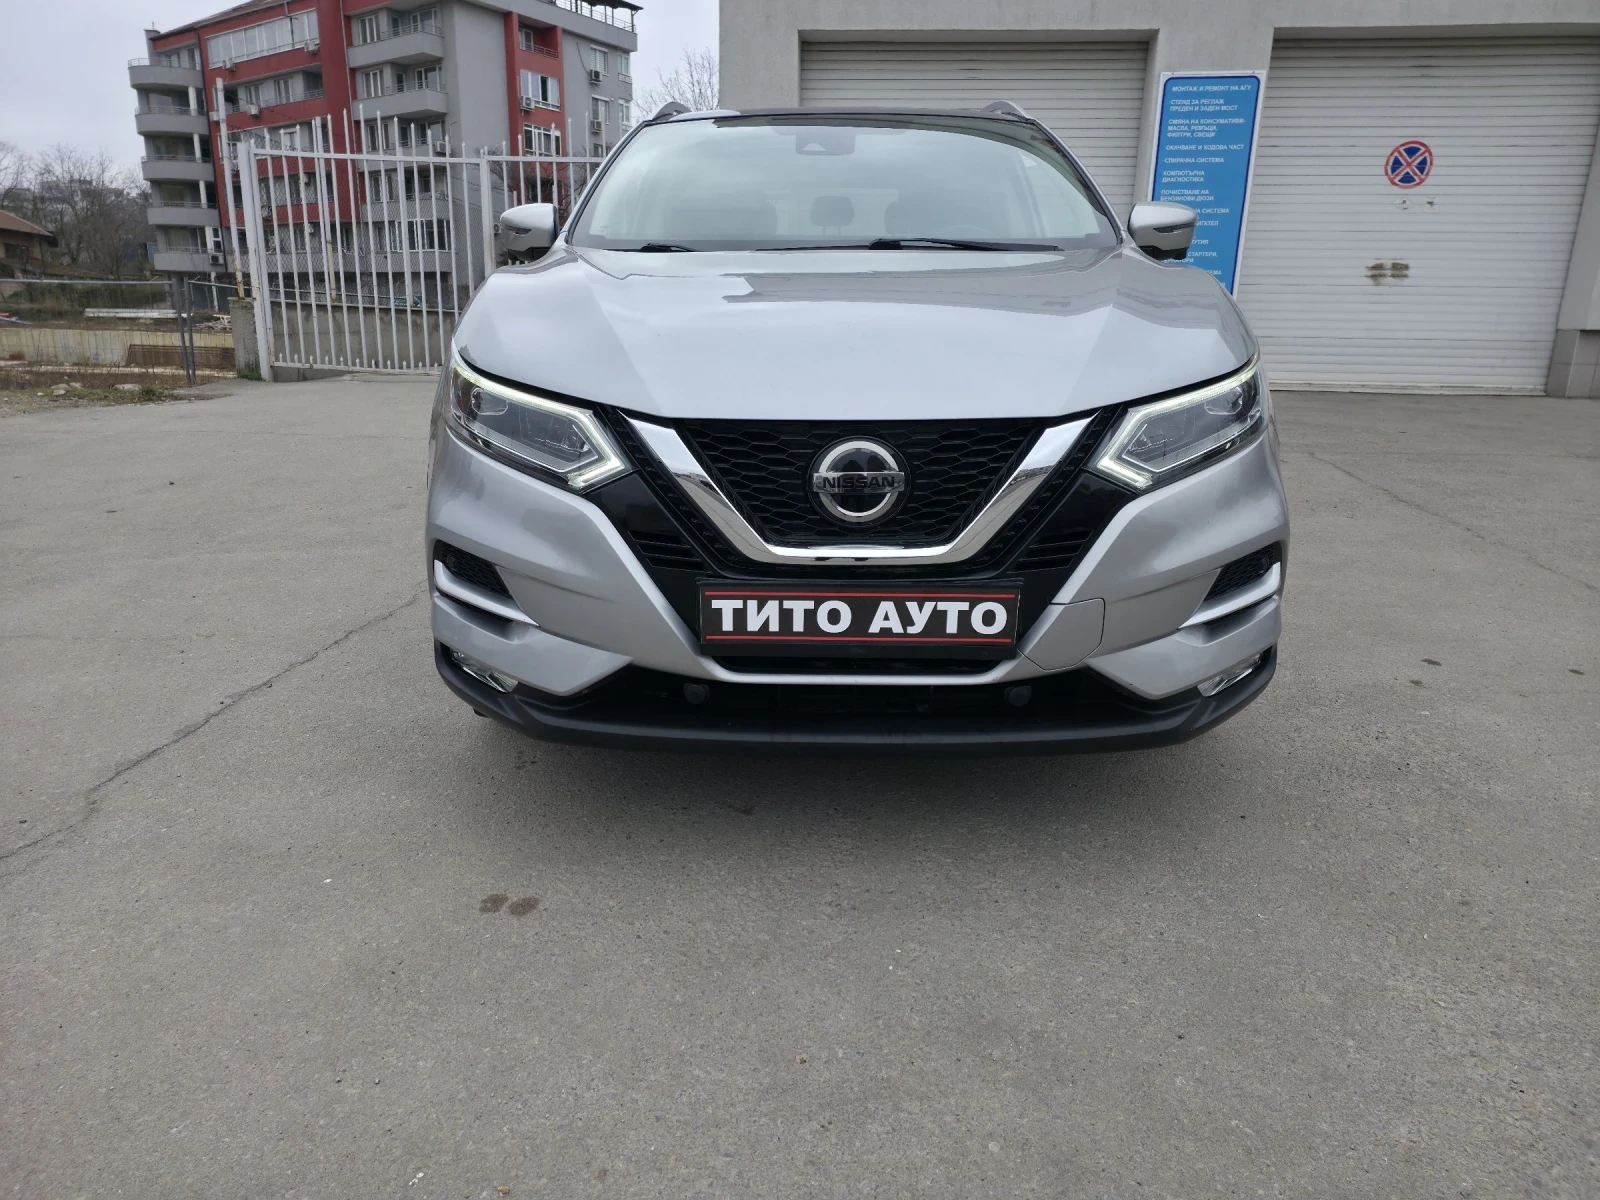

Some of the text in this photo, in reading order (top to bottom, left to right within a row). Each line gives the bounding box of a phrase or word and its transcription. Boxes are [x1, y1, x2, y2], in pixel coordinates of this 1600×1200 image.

[822, 476, 895, 489] NISSAN
[711, 599, 1008, 635] ТИТО АУТО
